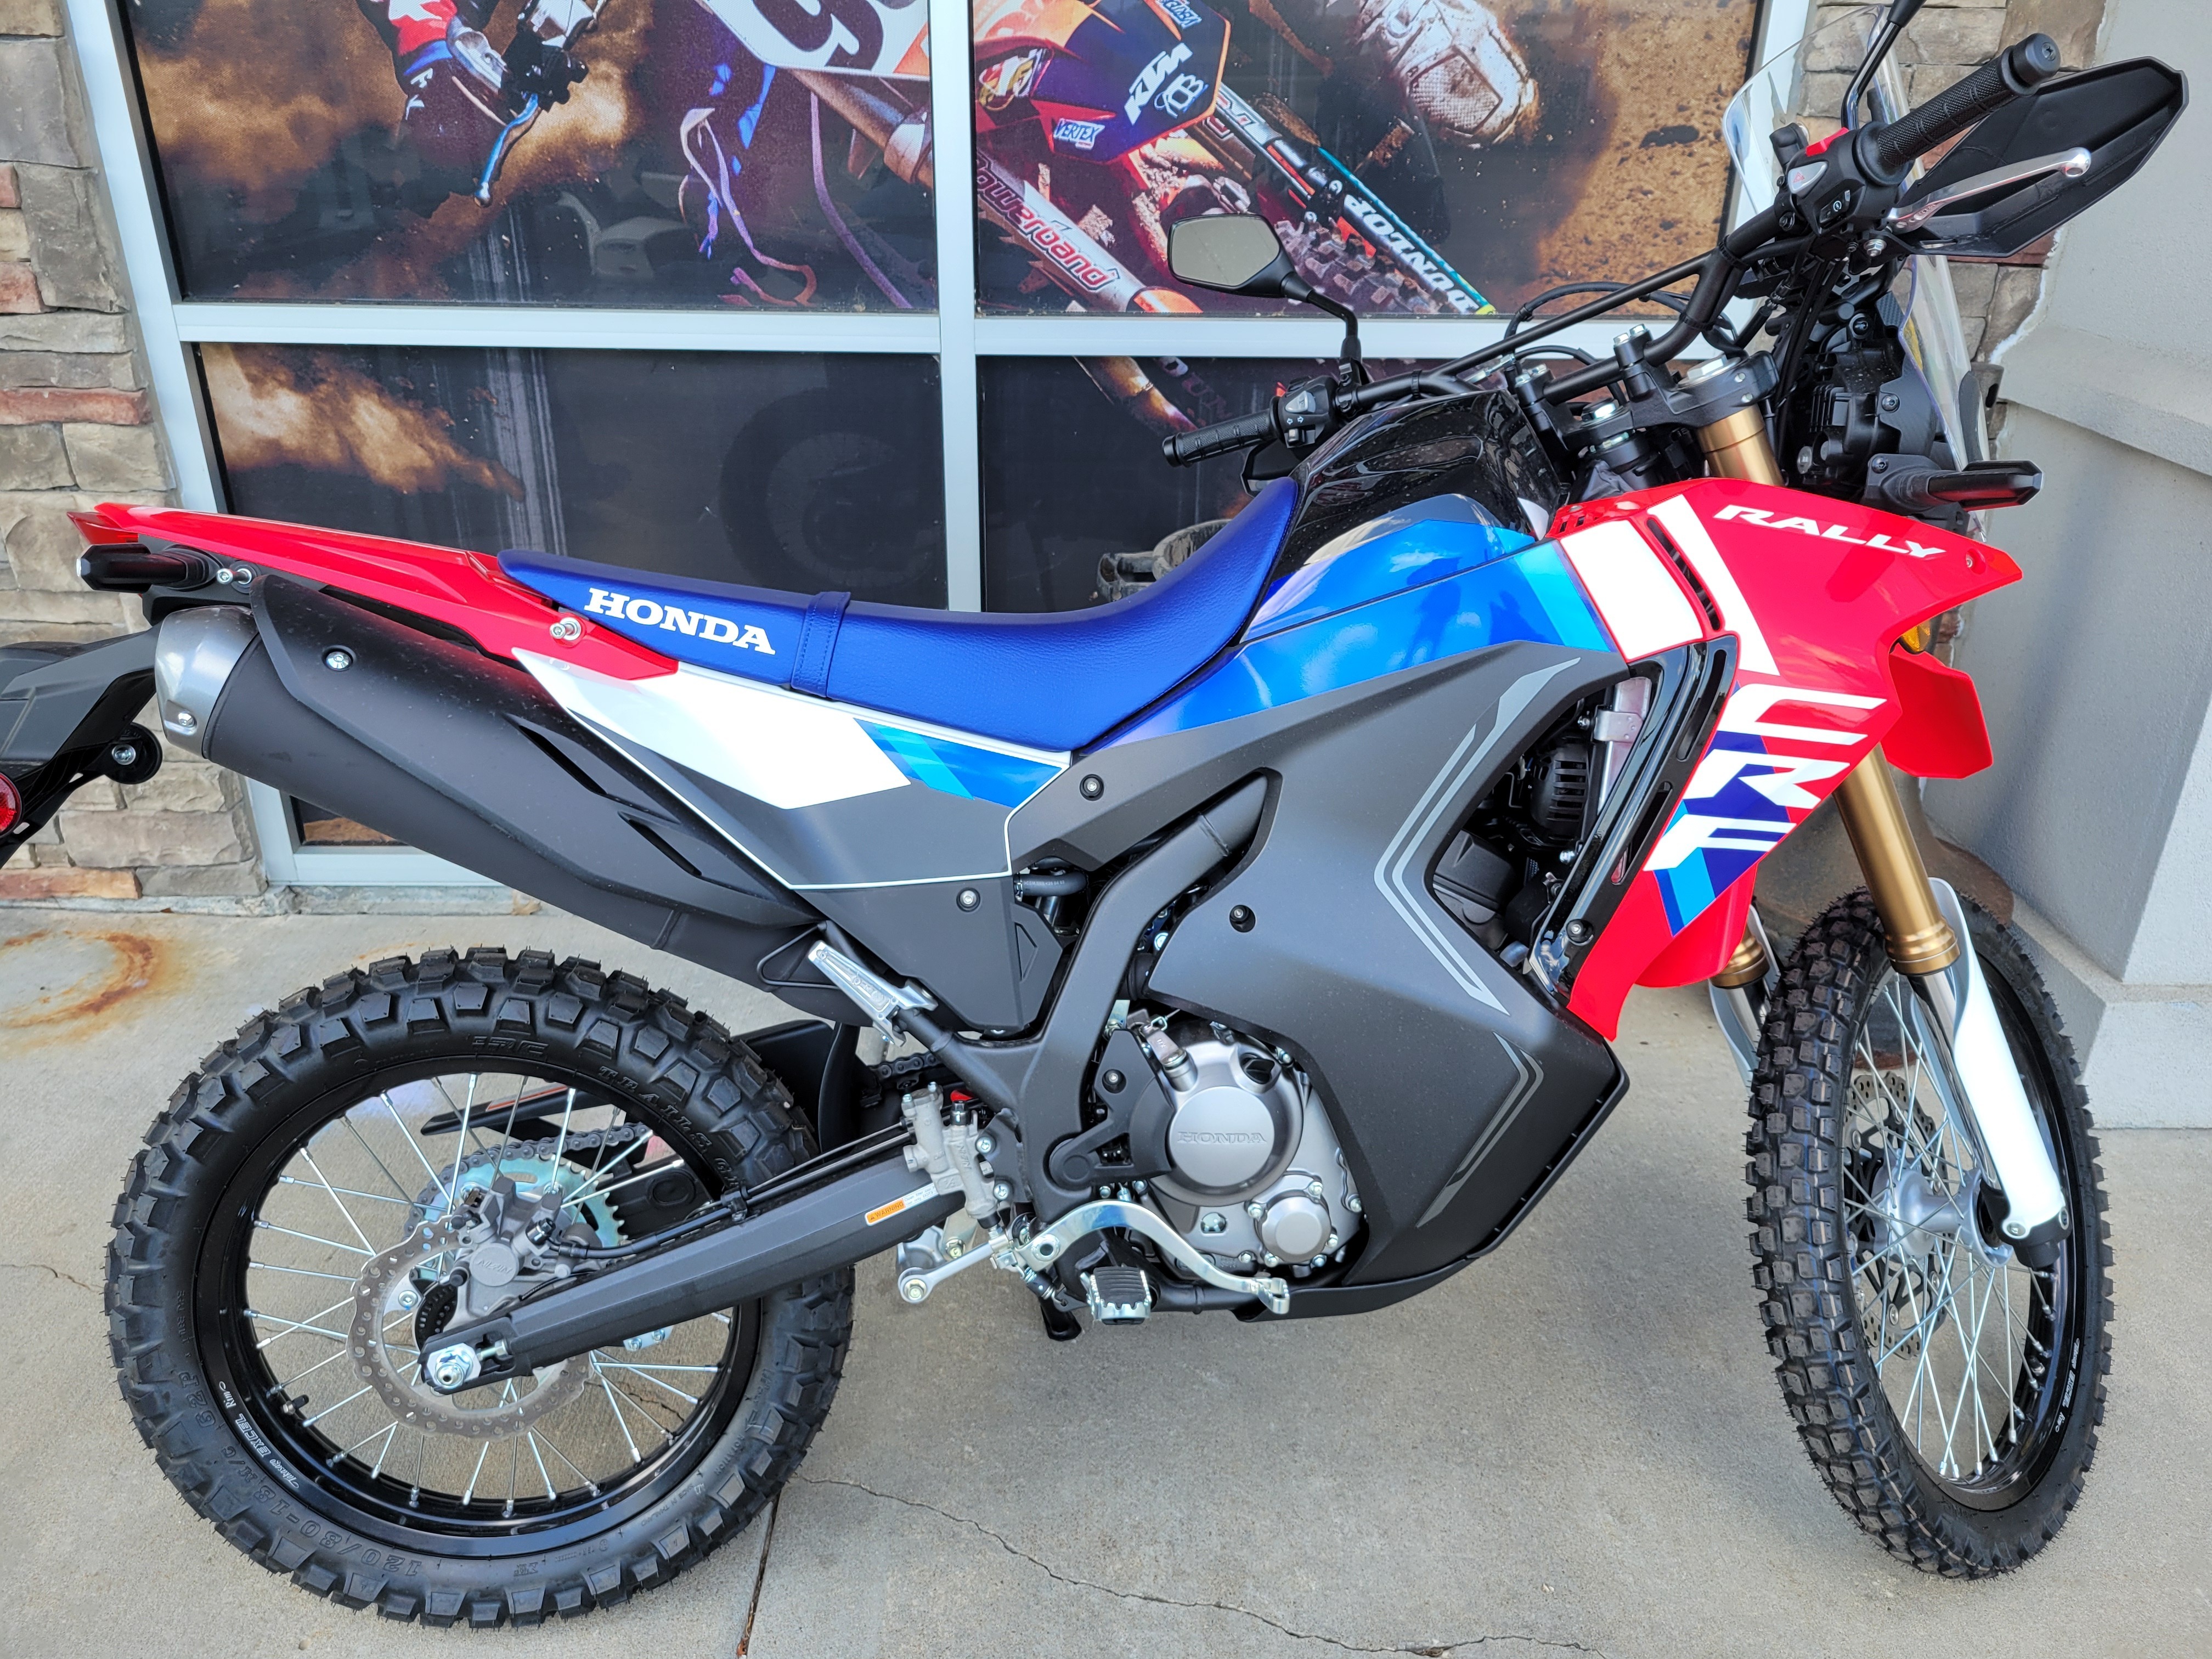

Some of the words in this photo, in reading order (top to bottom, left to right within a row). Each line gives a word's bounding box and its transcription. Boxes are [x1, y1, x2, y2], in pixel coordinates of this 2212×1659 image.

[1124, 42, 1194, 126] KTM
[1054, 119, 1101, 142] VERTEX
[1344, 194, 1480, 314] DUNLOP
[1713, 504, 1946, 558] RALLY
[584, 587, 776, 655] HONDA
[1643, 683, 1887, 872] CRF
[472, 1035, 549, 1055] IRC
[600, 1065, 712, 1155] TRAILS
[1177, 1131, 1267, 1145] HONDA
[875, 1201, 904, 1218] WARNING
[179, 1372, 217, 1428] 62P
[219, 1380, 237, 1409] Rim
[235, 1413, 272, 1458] EXCEL
[715, 1434, 745, 1476] ROTATION
[221, 1446, 258, 1483] M/C
[269, 1458, 300, 1488] Takasago
[253, 1485, 422, 1576] 120/80-18
